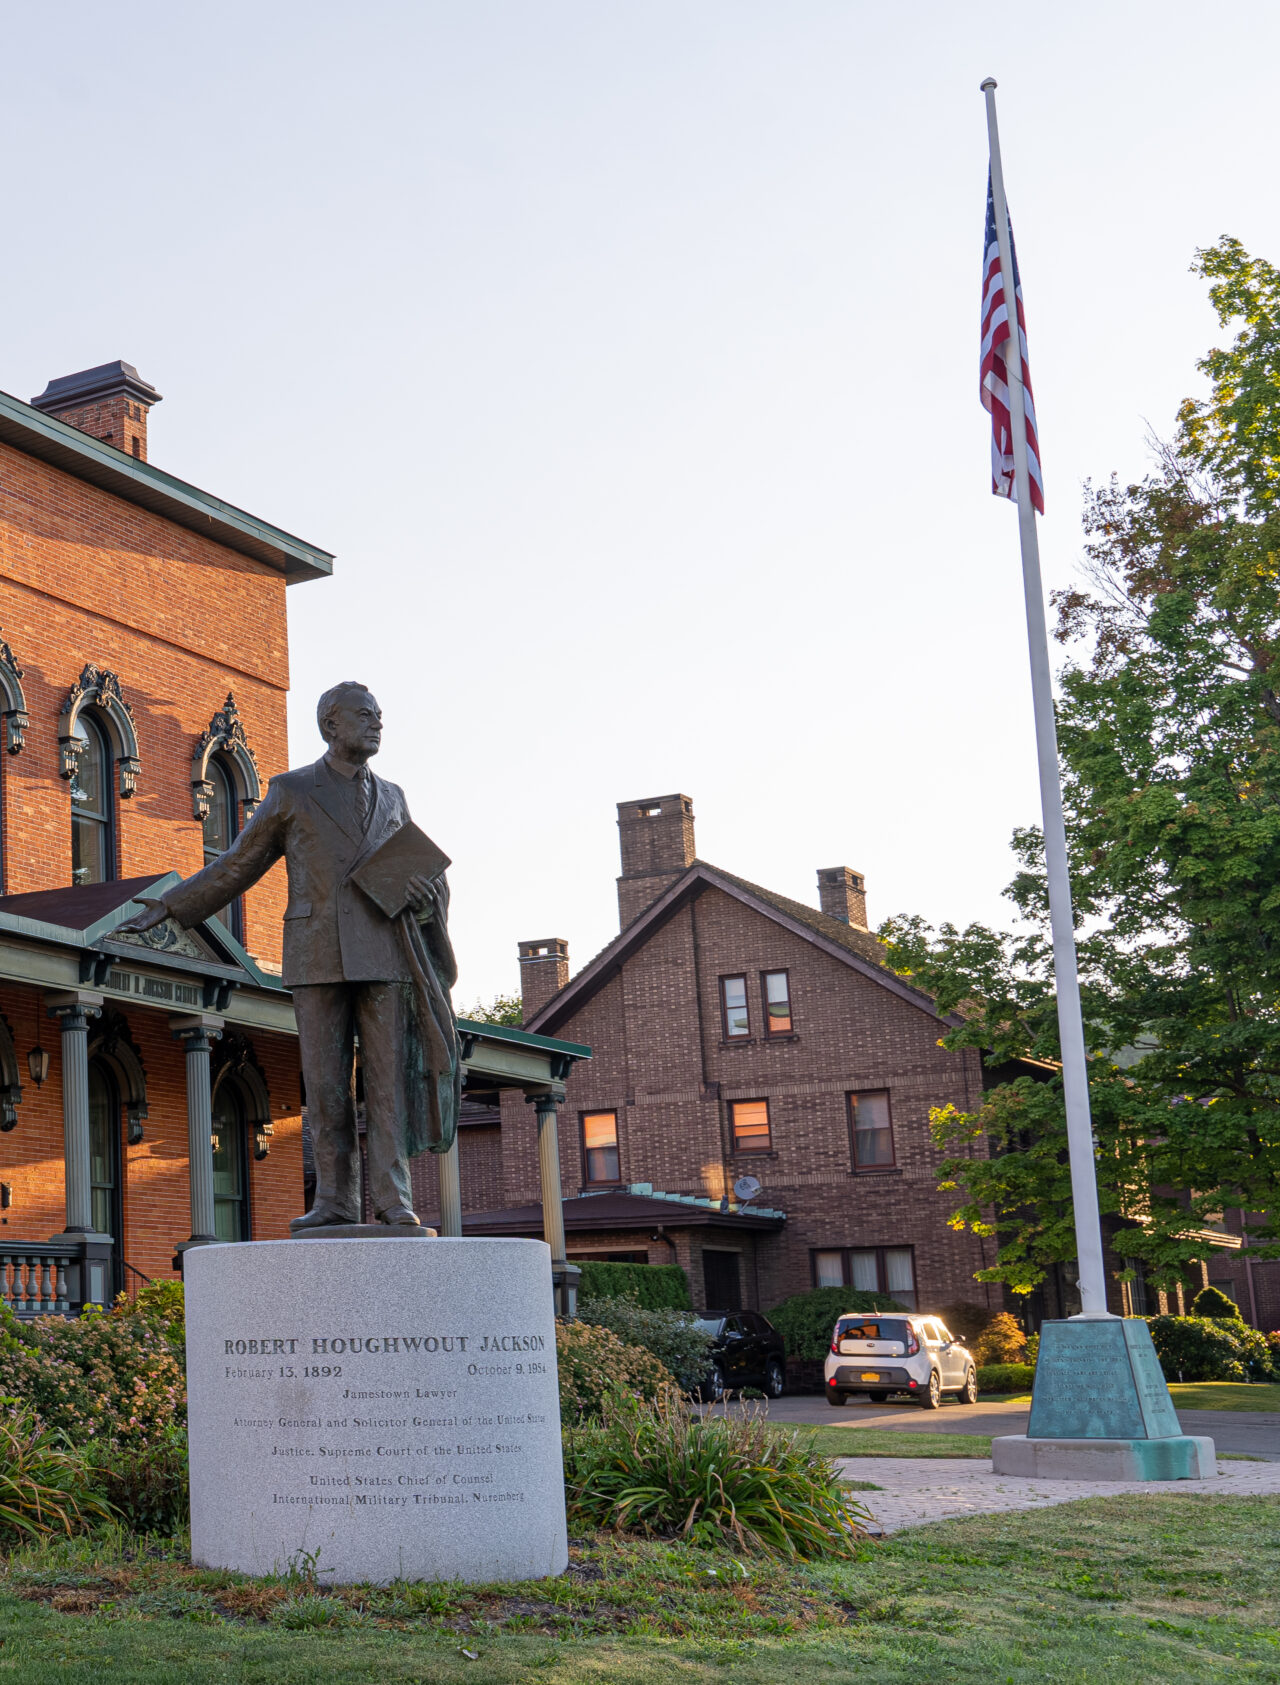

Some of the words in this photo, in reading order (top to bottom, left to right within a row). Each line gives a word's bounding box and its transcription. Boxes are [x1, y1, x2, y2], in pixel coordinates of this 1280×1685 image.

[224, 1339, 299, 1354] ROBERT
[312, 1337, 468, 1354] HOUGHWOUT
[480, 1336, 545, 1352] JACKSON
[225, 1367, 273, 1380] February
[304, 1366, 342, 1378] 1892
[468, 1364, 512, 1376] October
[528, 1362, 546, 1374] 1954
[342, 1389, 410, 1399] Jamestown
[416, 1388, 458, 1400] Lawyer
[234, 1418, 273, 1428] Attorney
[278, 1418, 321, 1428] General
[326, 1418, 348, 1428] and
[353, 1418, 407, 1427] Solicitor
[413, 1416, 457, 1427] General
[462, 1416, 472, 1426] of
[478, 1416, 492, 1424] the
[498, 1415, 524, 1424] United
[319, 1446, 372, 1458] Supreme
[376, 1446, 410, 1456] Court
[416, 1445, 428, 1455] of
[434, 1446, 451, 1455] the
[457, 1445, 492, 1454] United
[496, 1444, 522, 1454] States
[310, 1476, 350, 1486] United
[354, 1476, 392, 1486] States
[398, 1475, 430, 1486] Chief
[436, 1474, 448, 1484] of
[452, 1473, 494, 1484] Counsel
[273, 1494, 350, 1504] International
[356, 1494, 408, 1506] Military
